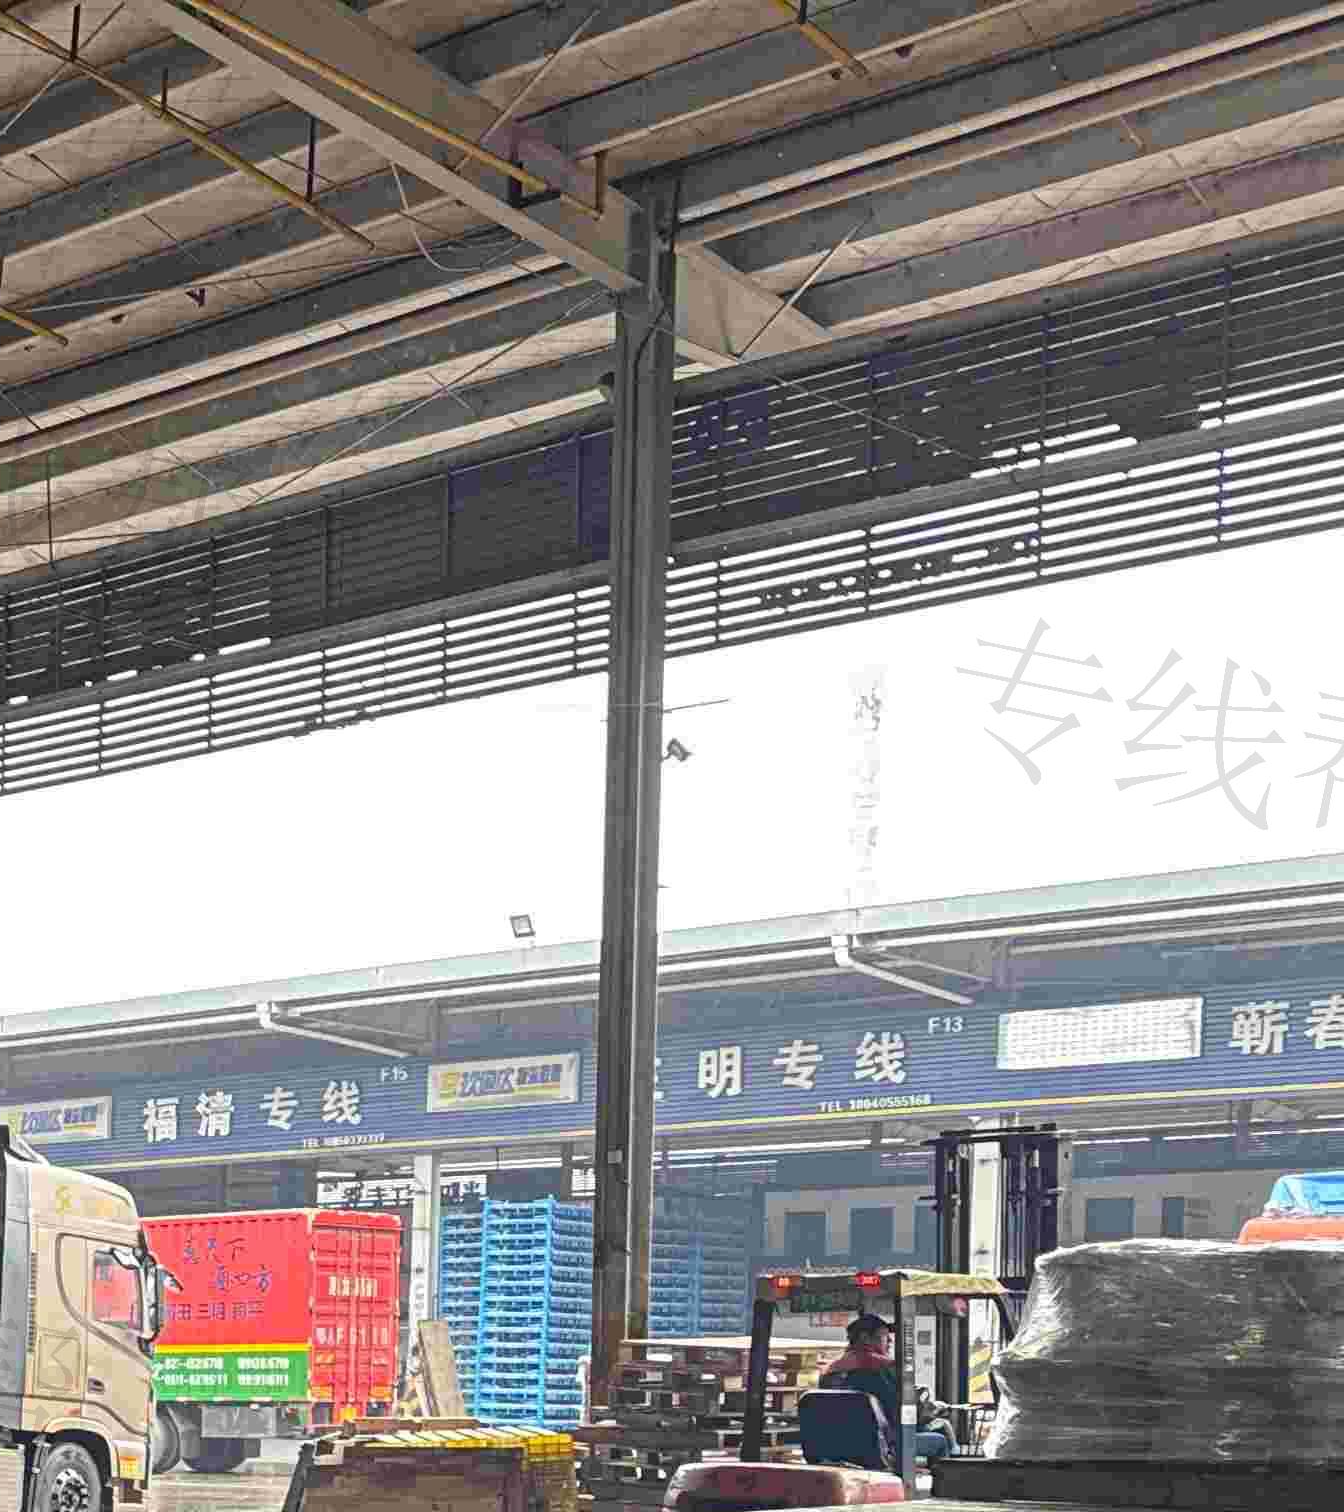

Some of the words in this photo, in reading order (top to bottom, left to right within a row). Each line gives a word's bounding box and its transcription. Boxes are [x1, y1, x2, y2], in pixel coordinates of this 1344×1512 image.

[928, 1016, 963, 1033] F13
[655, 1032, 906, 1098] 明专线
[143, 1079, 363, 1143] 福清专线
